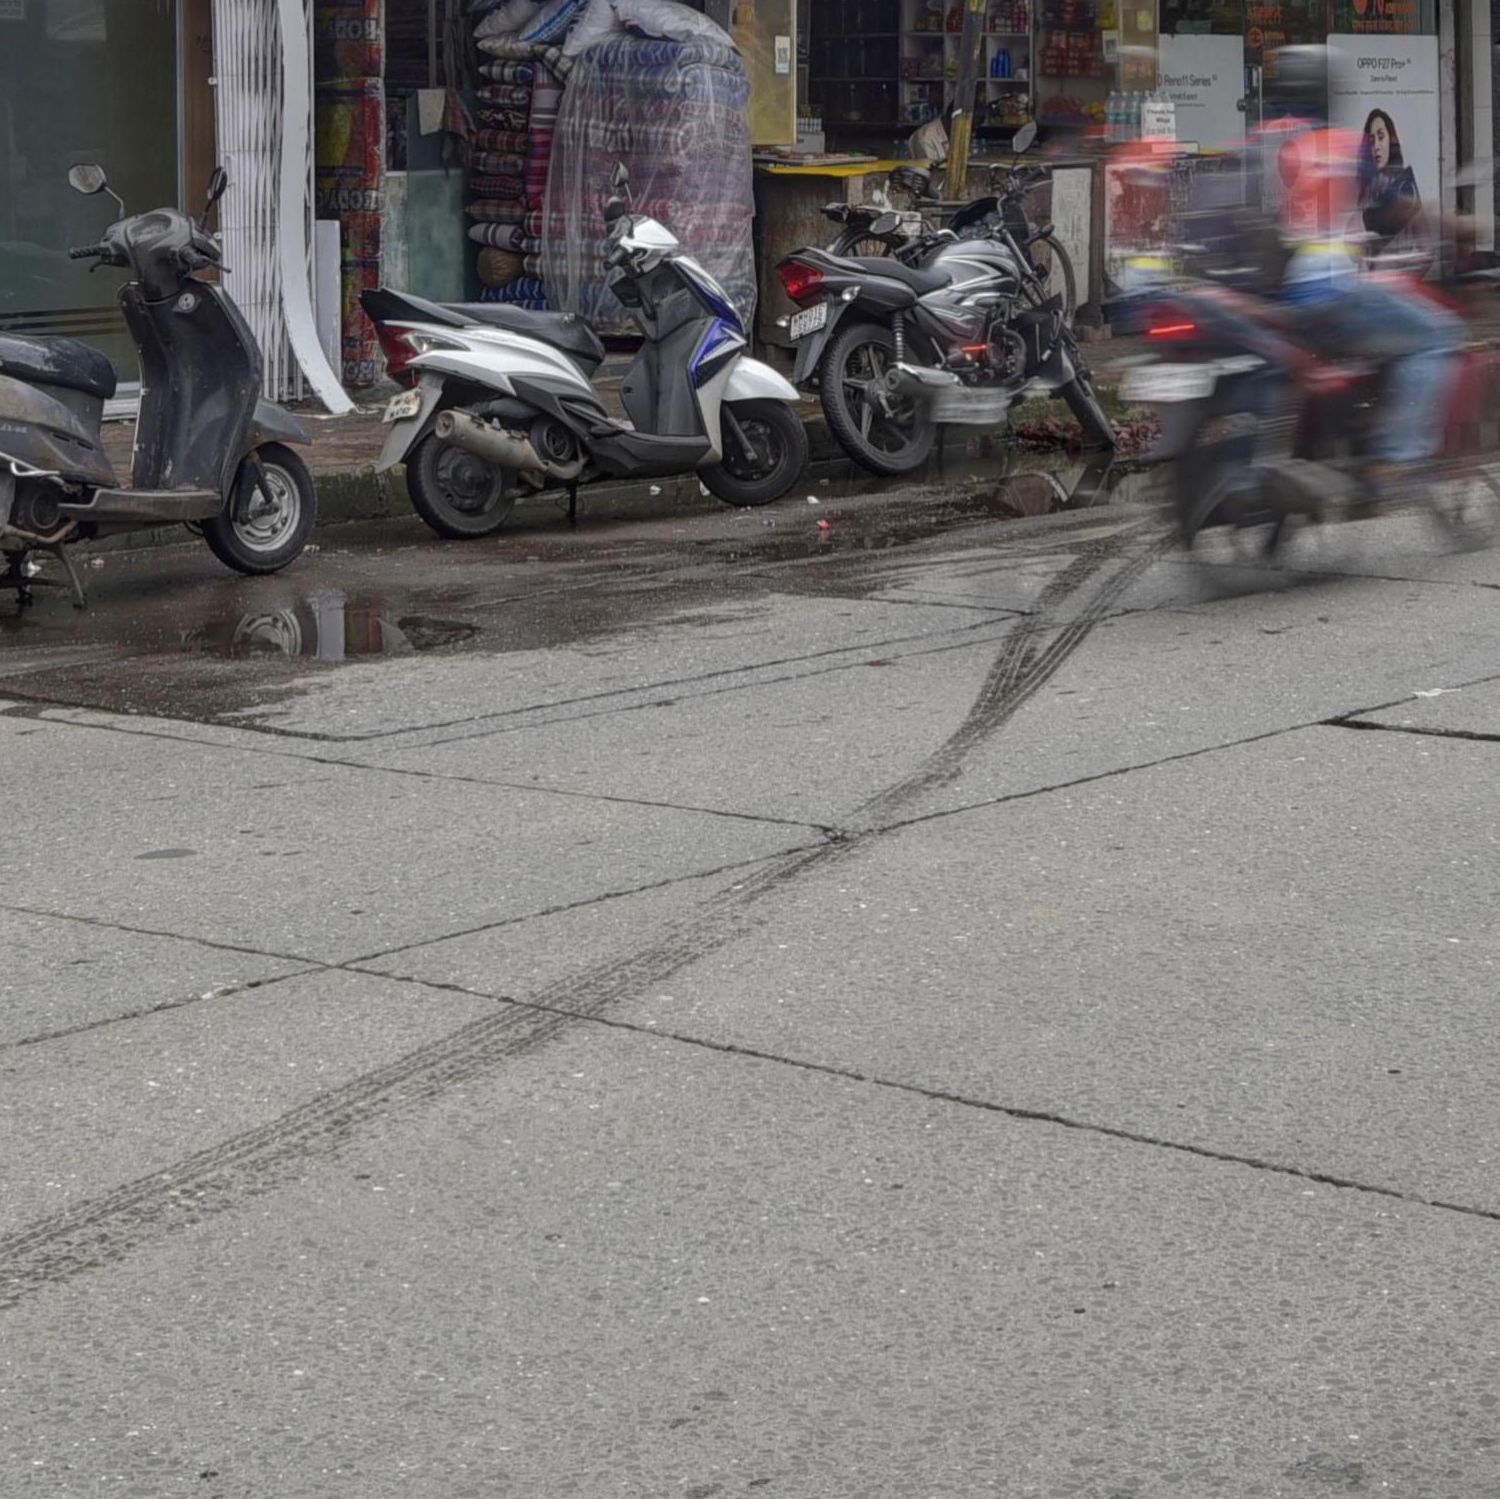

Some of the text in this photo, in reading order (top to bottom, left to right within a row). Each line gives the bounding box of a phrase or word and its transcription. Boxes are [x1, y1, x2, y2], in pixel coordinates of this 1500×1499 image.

[1357, 58, 1376, 69] OPPO
[1378, 58, 1389, 69] F27
[1164, 74, 1211, 87] Reno11 Series
